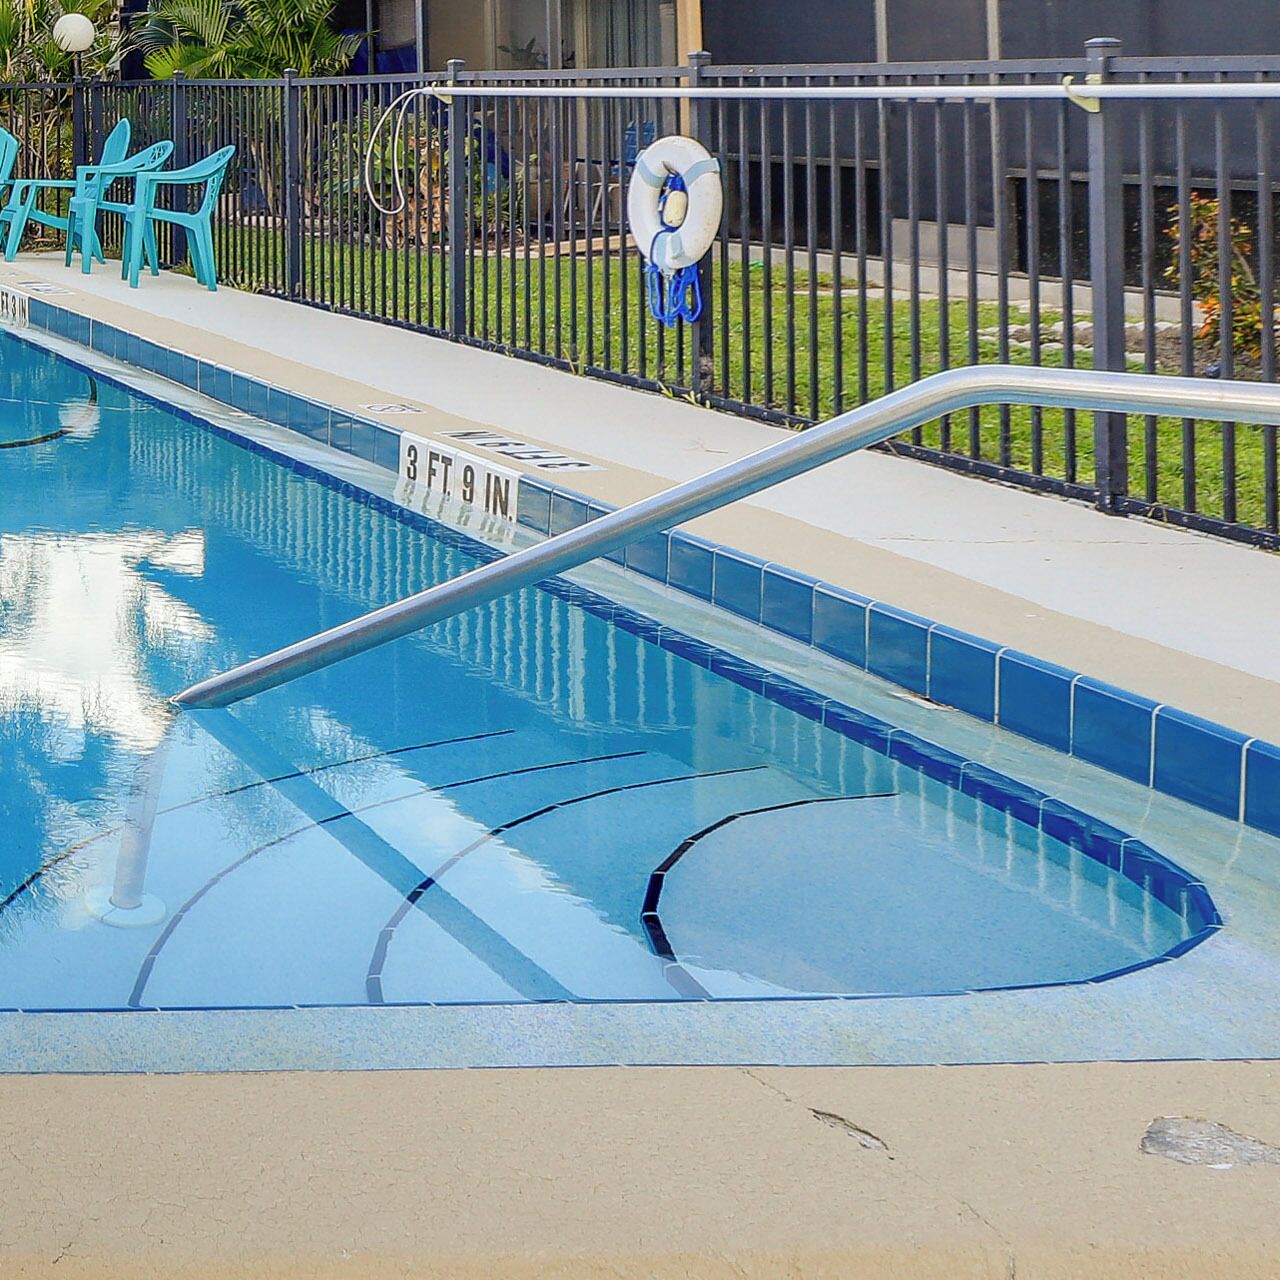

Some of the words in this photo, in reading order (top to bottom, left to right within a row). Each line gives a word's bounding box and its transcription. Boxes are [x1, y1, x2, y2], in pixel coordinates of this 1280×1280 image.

[1, 291, 9, 314] FT
[11, 295, 16, 317] 3
[18, 297, 26, 319] IN
[406, 444, 418, 481] 3
[462, 465, 475, 504] 9
